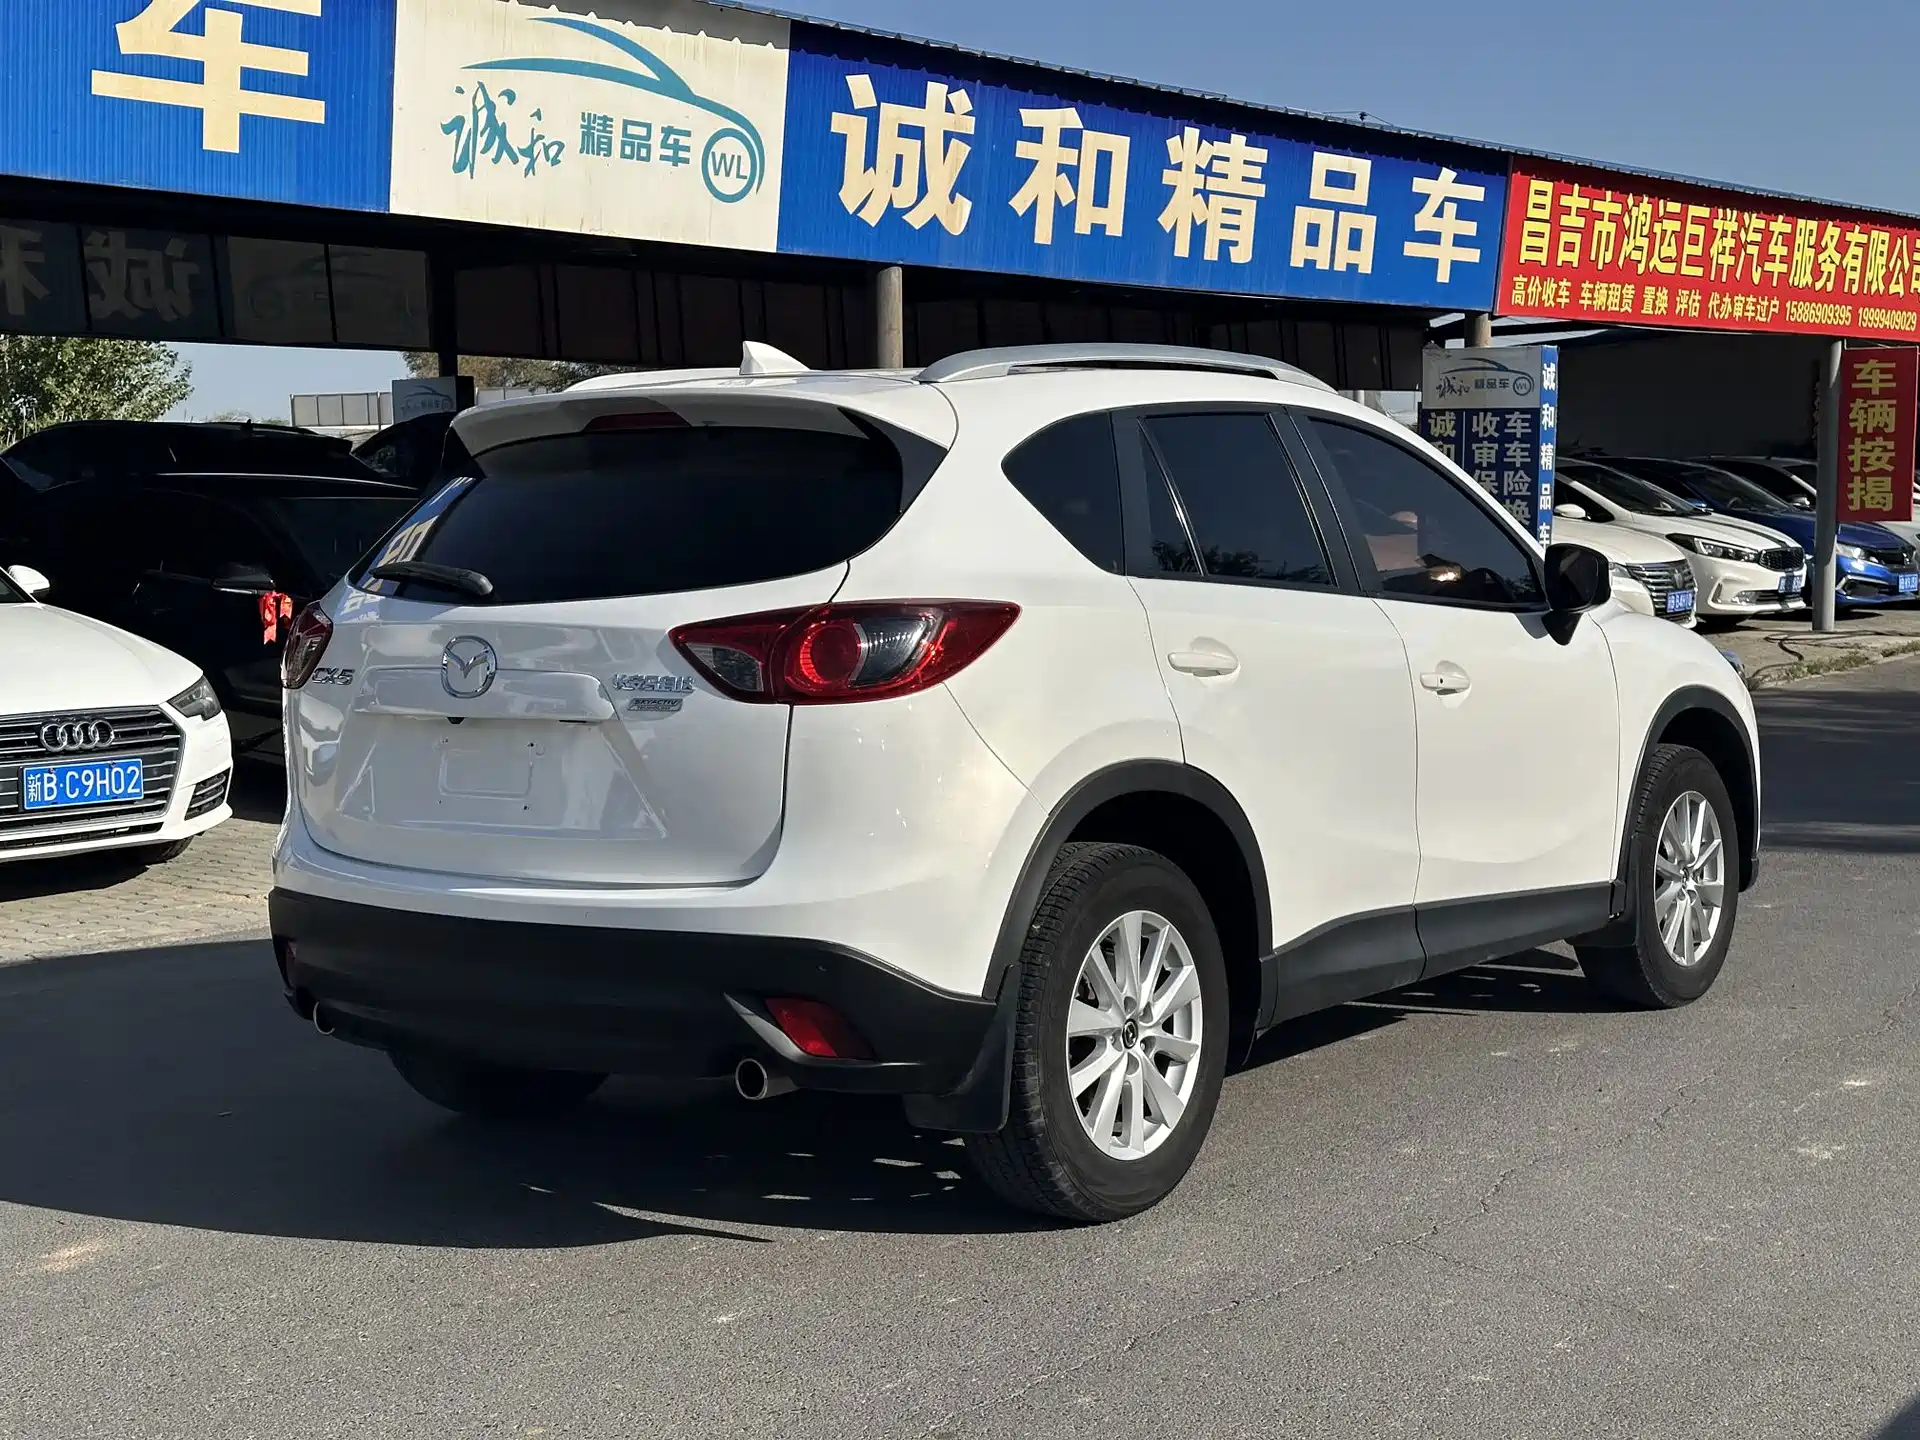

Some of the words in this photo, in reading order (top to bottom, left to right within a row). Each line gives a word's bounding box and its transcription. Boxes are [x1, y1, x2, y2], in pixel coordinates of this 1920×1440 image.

[579, 111, 692, 167] 精品车
[711, 151, 748, 180] WL
[830, 73, 1485, 283] 诚和精品车
[1511, 274, 1571, 309] 高价收车
[1579, 281, 1635, 313] 车辆租赁
[1641, 286, 1669, 316] 置换
[1675, 288, 1701, 319] 评估
[1708, 291, 1780, 323] 代办审车过户
[1785, 300, 1853, 327] 15886909395
[1858, 306, 1917, 332] 19999409029
[1472, 411, 1532, 438] 收车
[1847, 359, 1896, 512] 车辆按揭
[1471, 440, 1531, 467] 审车
[1539, 362, 1556, 549] 诚和精品车
